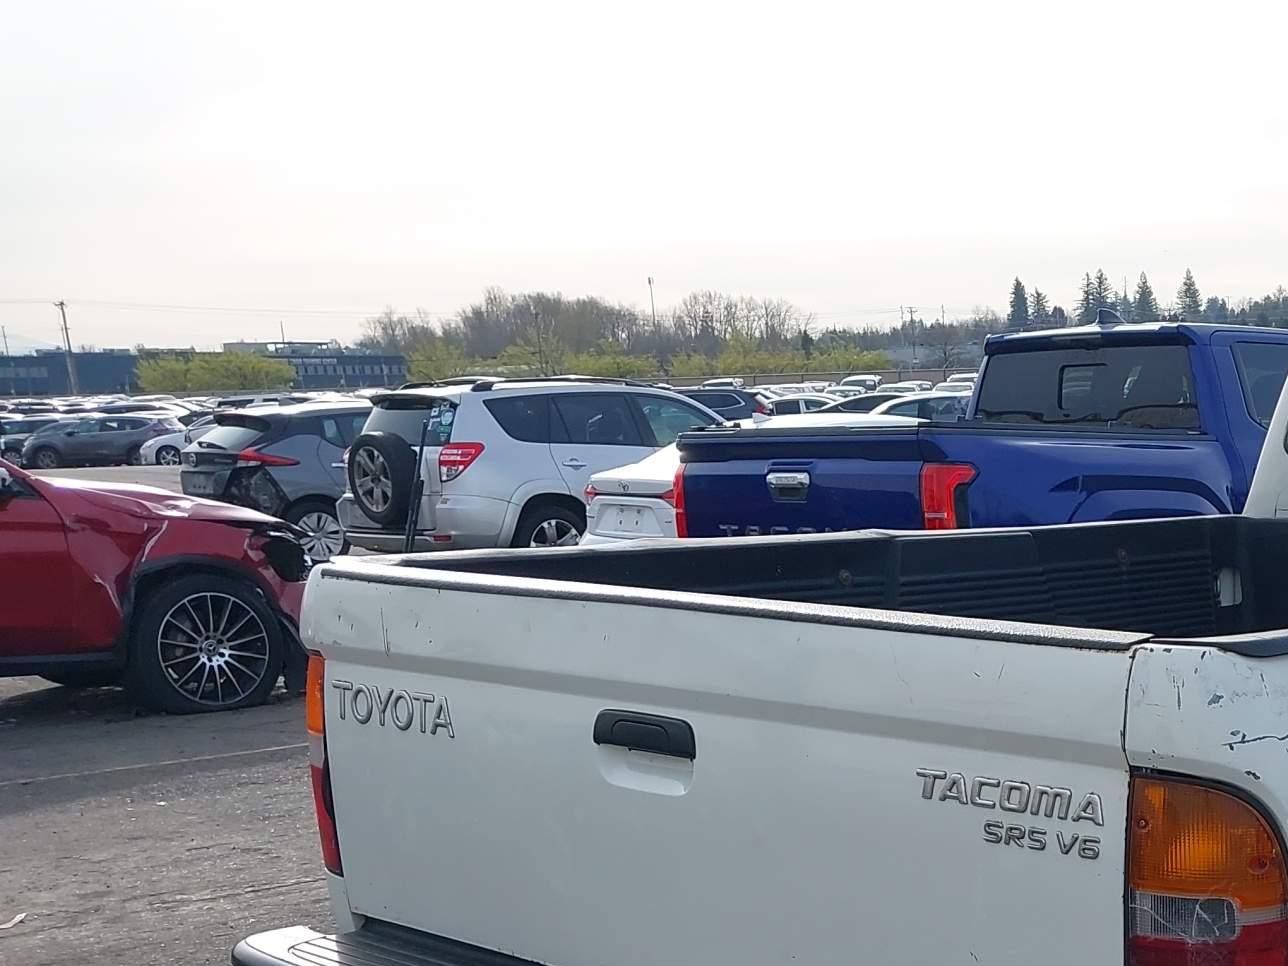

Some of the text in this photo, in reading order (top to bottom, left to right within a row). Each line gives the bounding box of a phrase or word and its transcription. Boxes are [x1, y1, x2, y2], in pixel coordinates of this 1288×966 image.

[331, 679, 455, 739] TOYOTA
[915, 767, 1105, 827] TACOMA
[983, 819, 1101, 860] SR5 V6
